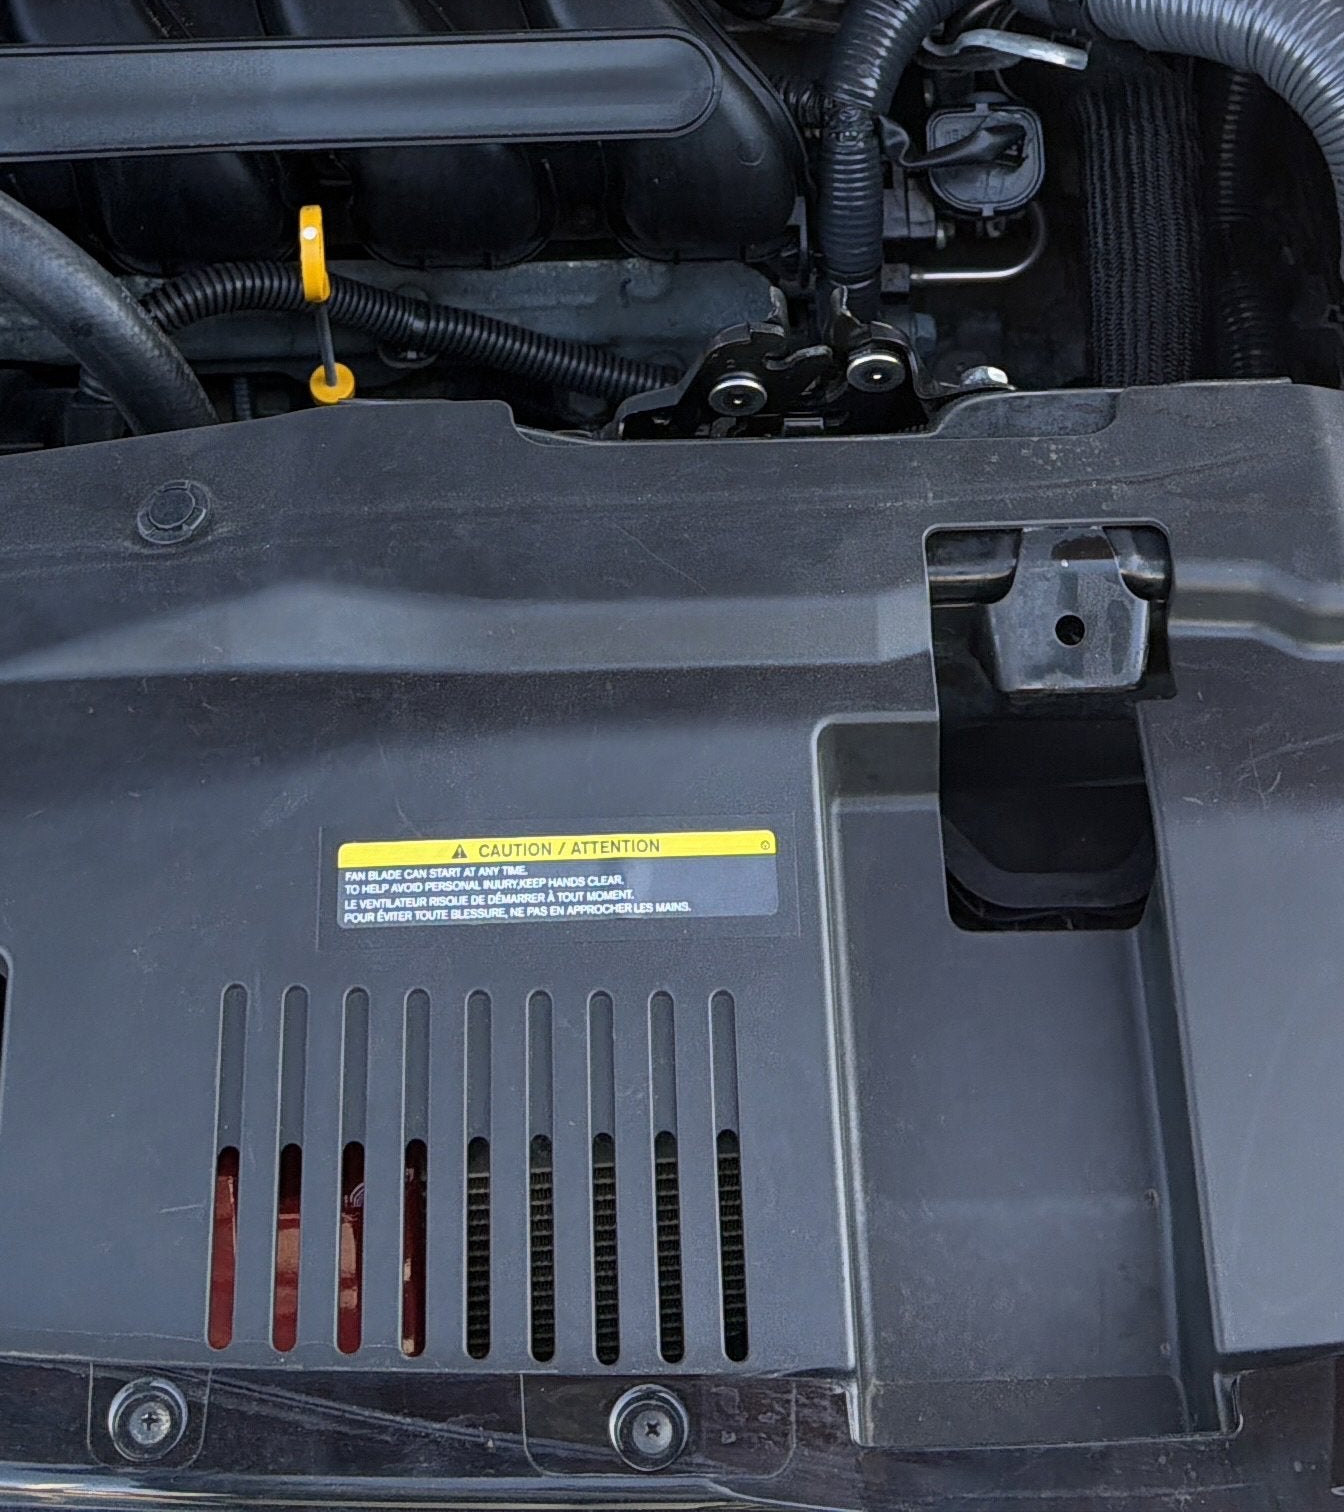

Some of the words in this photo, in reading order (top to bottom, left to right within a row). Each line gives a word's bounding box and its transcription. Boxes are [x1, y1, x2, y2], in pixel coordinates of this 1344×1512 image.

[478, 842, 552, 858] CAUTION
[571, 839, 660, 855] ATTENTION
[345, 871, 366, 882] FAN
[367, 870, 403, 881] BLADE
[404, 869, 427, 880] CAN
[429, 868, 461, 879] START
[463, 867, 477, 878] AT
[478, 866, 500, 877] ANY
[345, 885, 360, 895] TO
[362, 883, 389, 894] HELP
[391, 882, 423, 893] AVOID
[424, 880, 481, 892] PERSONAL
[548, 876, 585, 888] HANDS
[345, 900, 357, 910] LE
[359, 897, 428, 909] VENTILATEUR
[429, 896, 469, 907] RISQUE
[471, 895, 486, 905] DE
[488, 891, 545, 904] DÉMARRER
[547, 889, 556, 902] À
[557, 891, 585, 902] TOUT
[344, 912, 375, 923] POUR
[377, 910, 413, 922] ÉVITER
[415, 910, 449, 921] TOUTE
[510, 907, 525, 917] NE
[527, 905, 548, 917] PAS
[550, 906, 565, 916] EN
[567, 904, 632, 915] APPROCHER
[634, 903, 654, 913] LES
